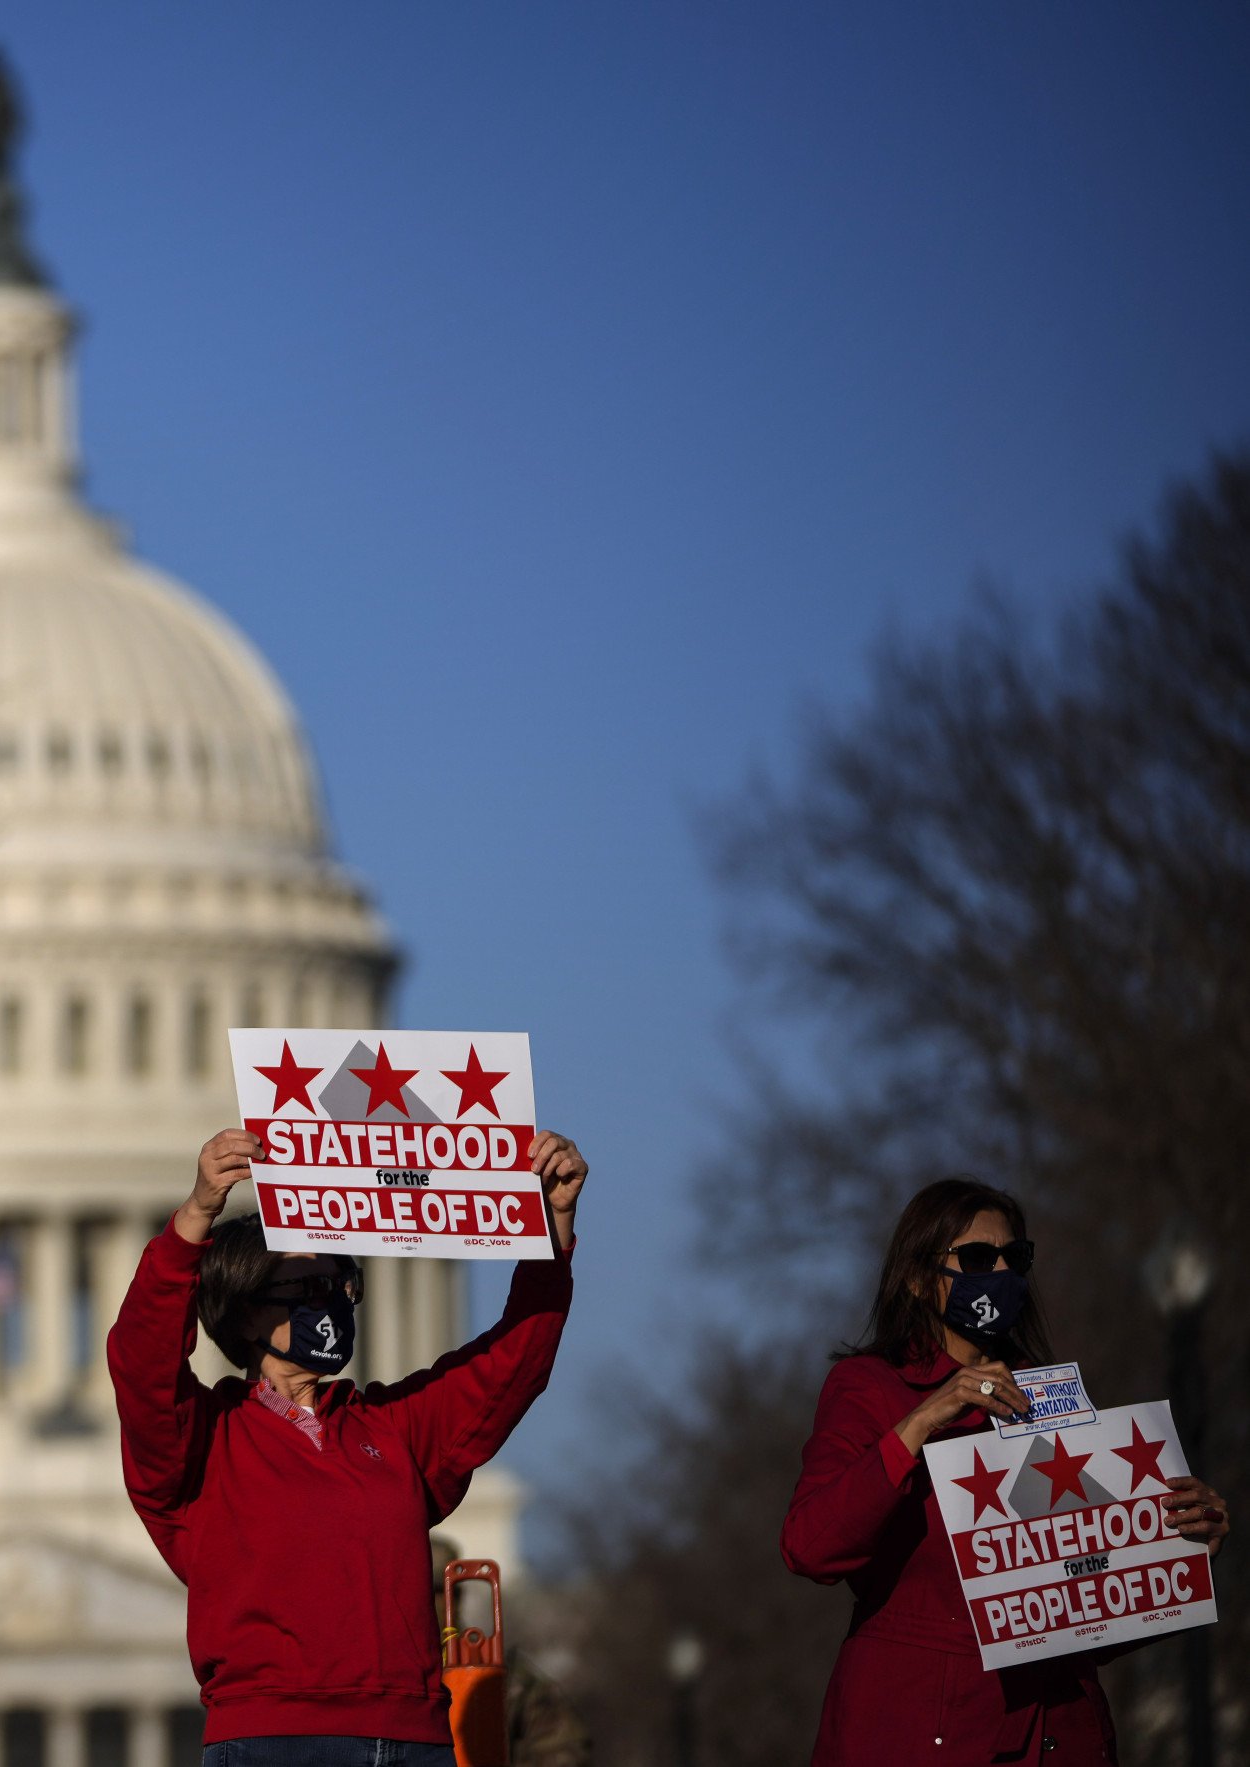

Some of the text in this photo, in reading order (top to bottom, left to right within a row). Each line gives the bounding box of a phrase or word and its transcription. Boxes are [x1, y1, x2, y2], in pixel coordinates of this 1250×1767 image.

[266, 1121, 517, 1170] STATEHOOD
[376, 1169, 430, 1186] for the
[274, 1188, 525, 1235] PEOPLE OF DC
[307, 1231, 512, 1248] @51stDC @51for51 @DC_Vote
[975, 1301, 995, 1319] 51
[320, 1323, 339, 1340] 51
[1043, 1381, 1081, 1398] WITHOUT
[1064, 1556, 1109, 1577] for the
[984, 1561, 1193, 1640] PEOPLE OF DC
[1015, 1609, 1182, 1649] @51stDC @51for51 @DC_Vote
